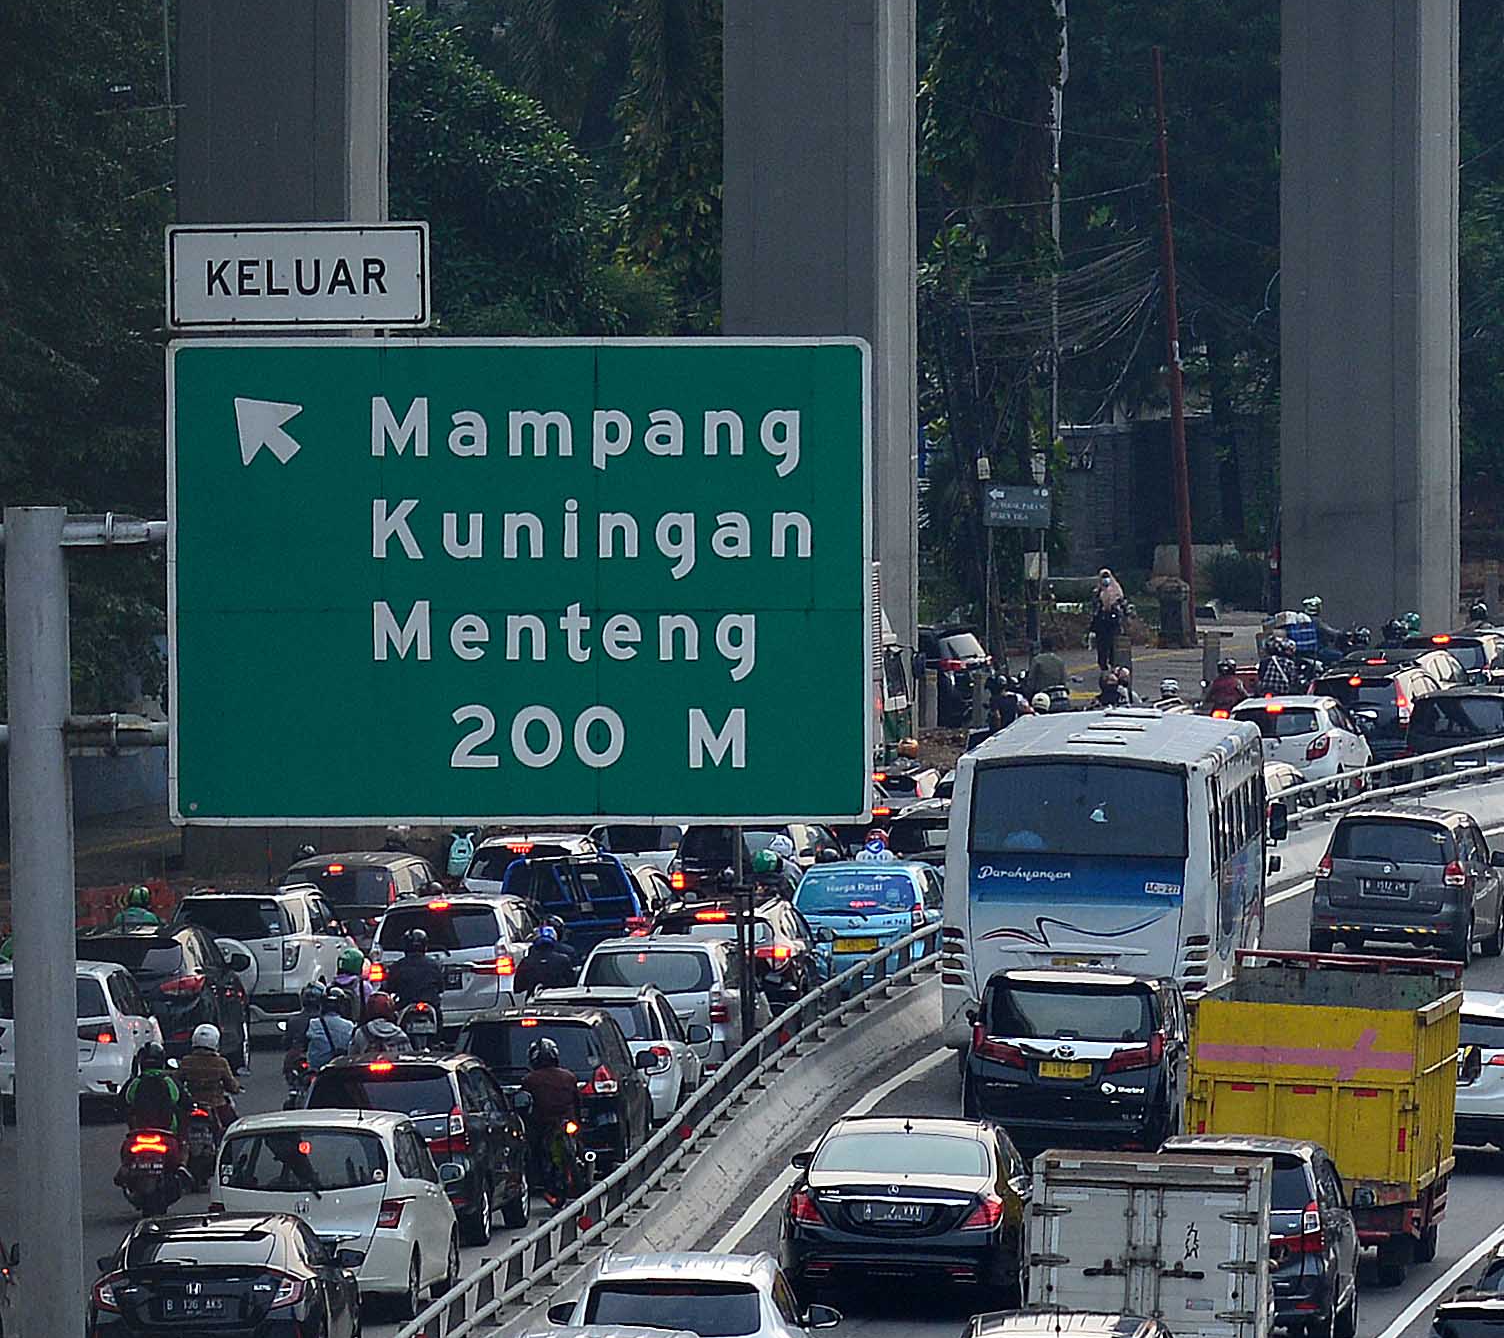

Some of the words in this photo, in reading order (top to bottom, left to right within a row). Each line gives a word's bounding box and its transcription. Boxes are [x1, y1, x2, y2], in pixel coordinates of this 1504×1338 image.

[204, 257, 389, 297] KELUAR
[370, 395, 803, 478] Mampang
[371, 497, 814, 580] Kuningan
[372, 599, 758, 681] Menteng
[450, 703, 627, 769] 200
[688, 708, 748, 769] M
